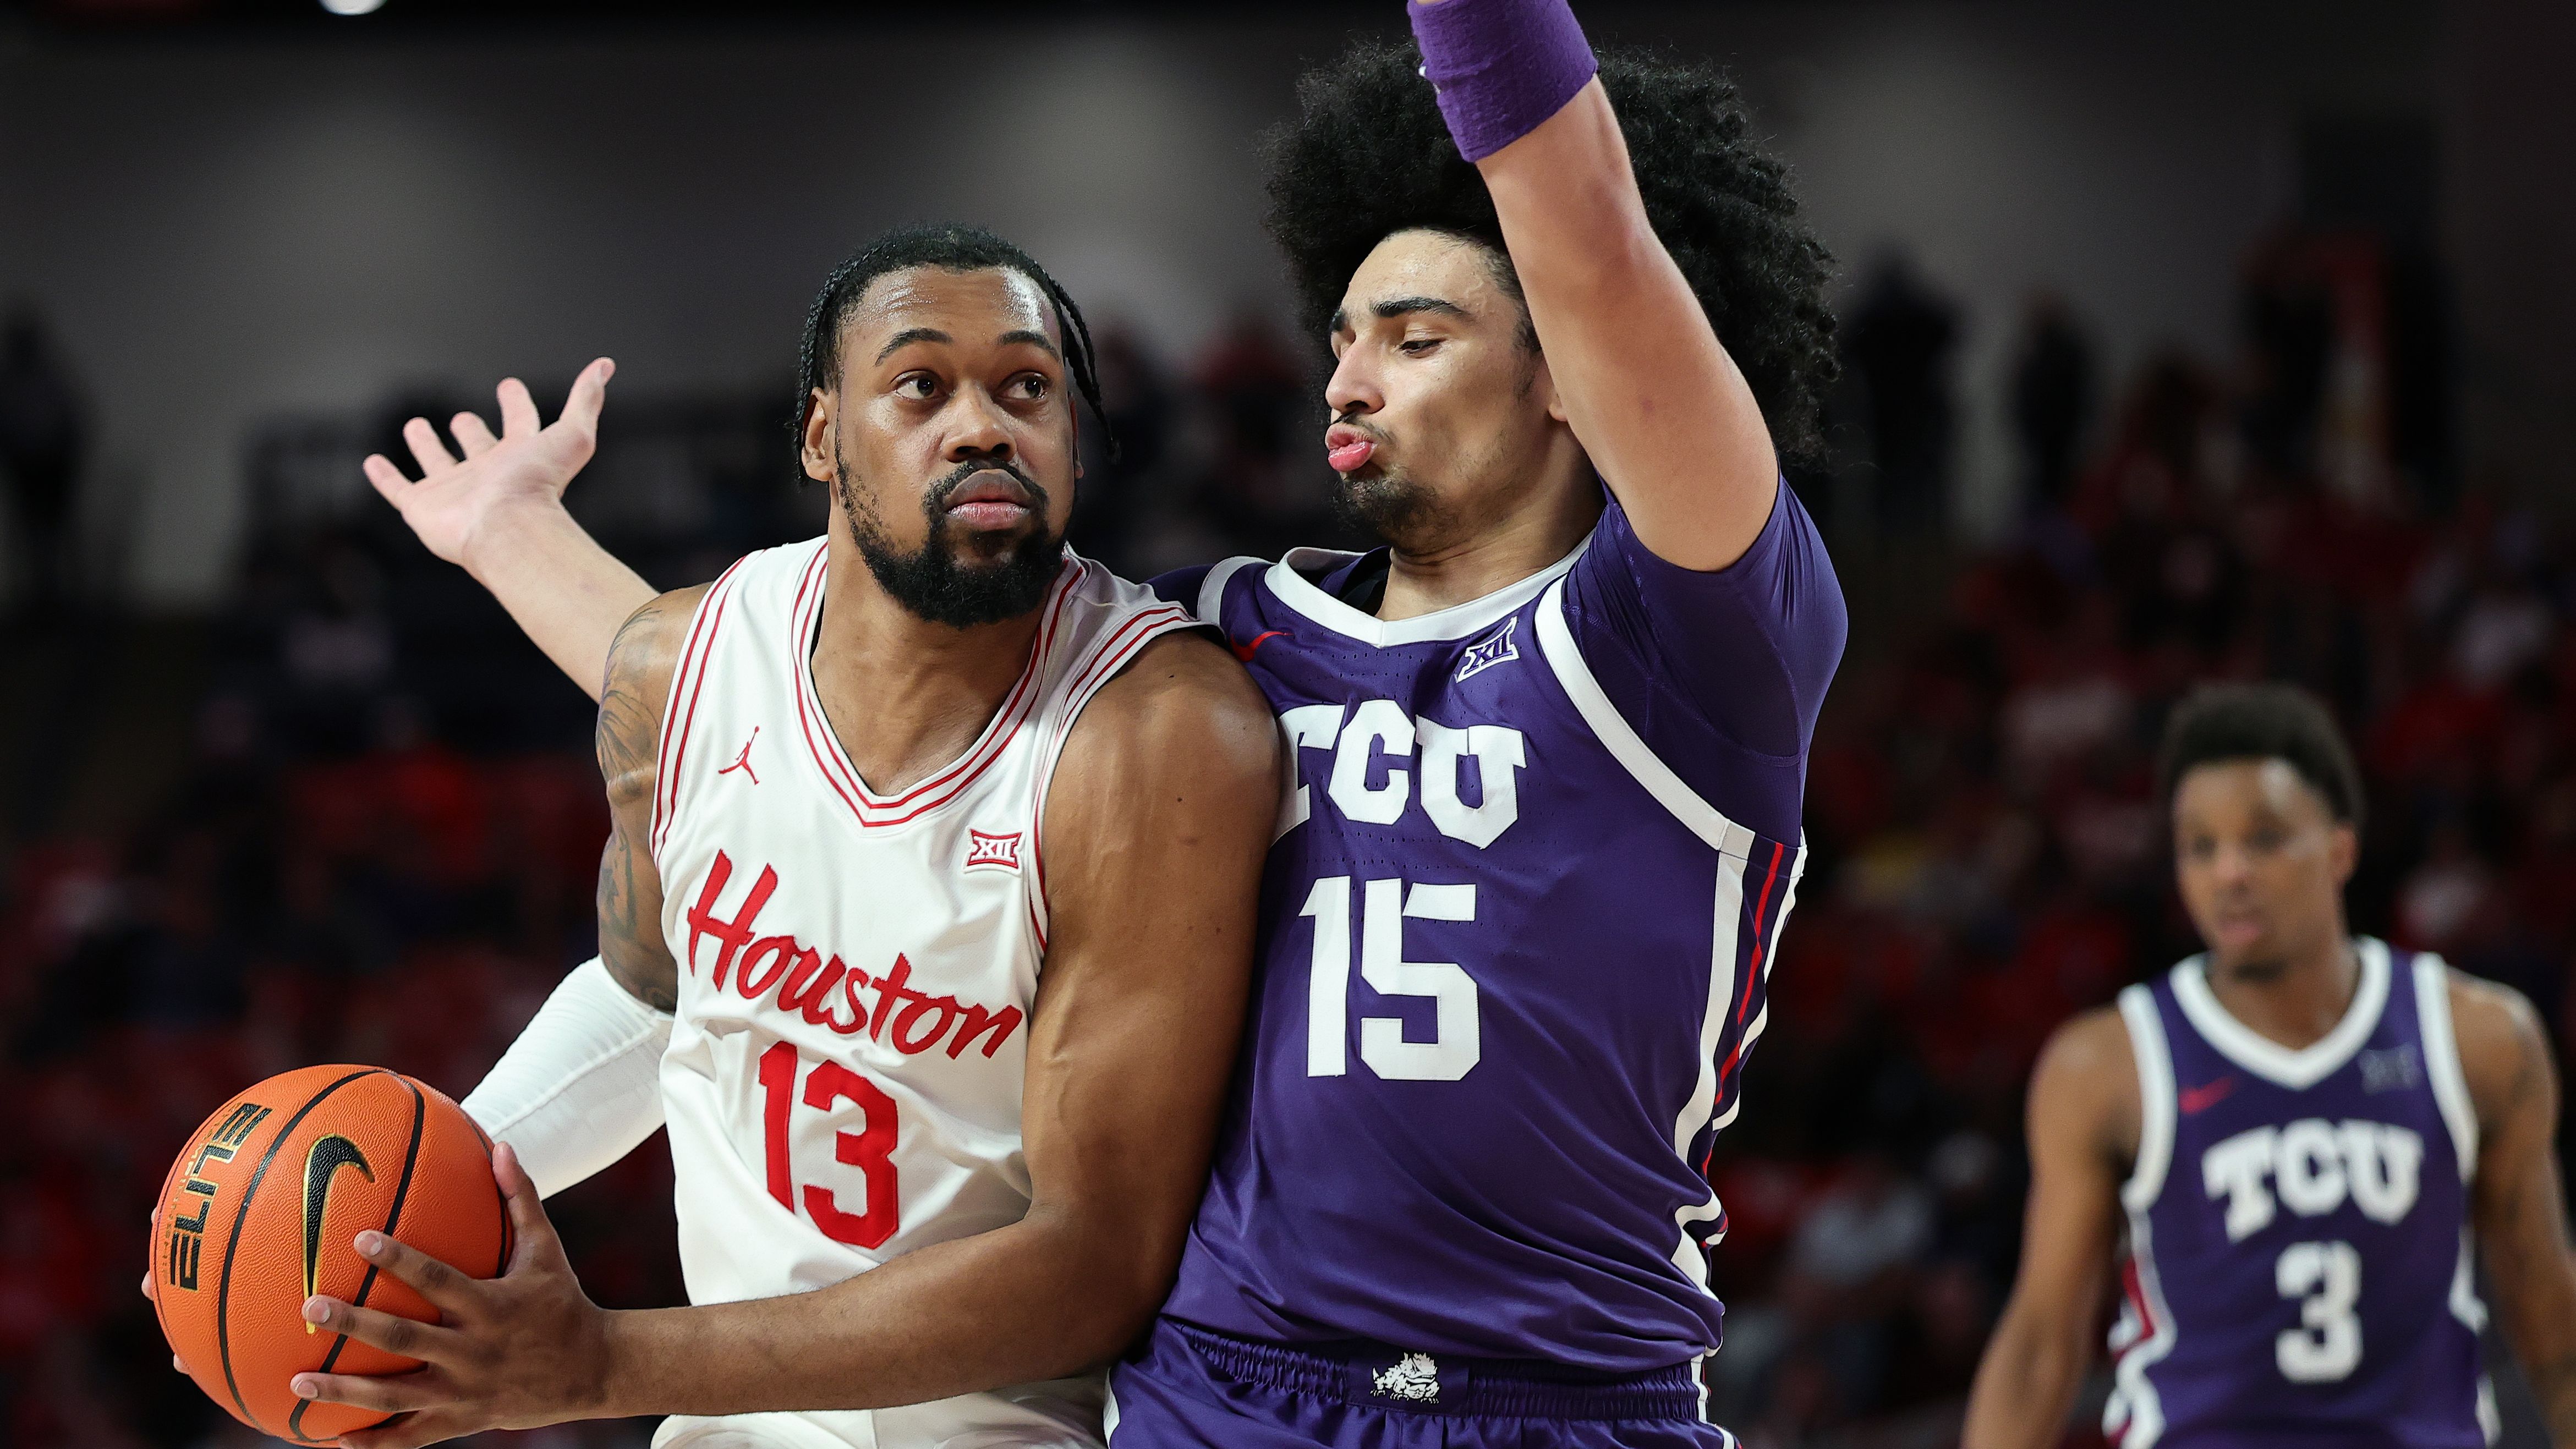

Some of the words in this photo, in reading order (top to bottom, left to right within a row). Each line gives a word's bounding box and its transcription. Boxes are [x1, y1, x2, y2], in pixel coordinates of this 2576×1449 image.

[1461, 622, 1515, 677] XII
[968, 833, 1020, 865] XII
[686, 849, 1022, 1060] Houston
[1298, 875, 1481, 1081] 15
[169, 1102, 273, 1291] ELITE
[759, 1040, 900, 1250] 13
[2202, 1117, 2424, 1243] TCU
[2276, 1241, 2363, 1383] 3
